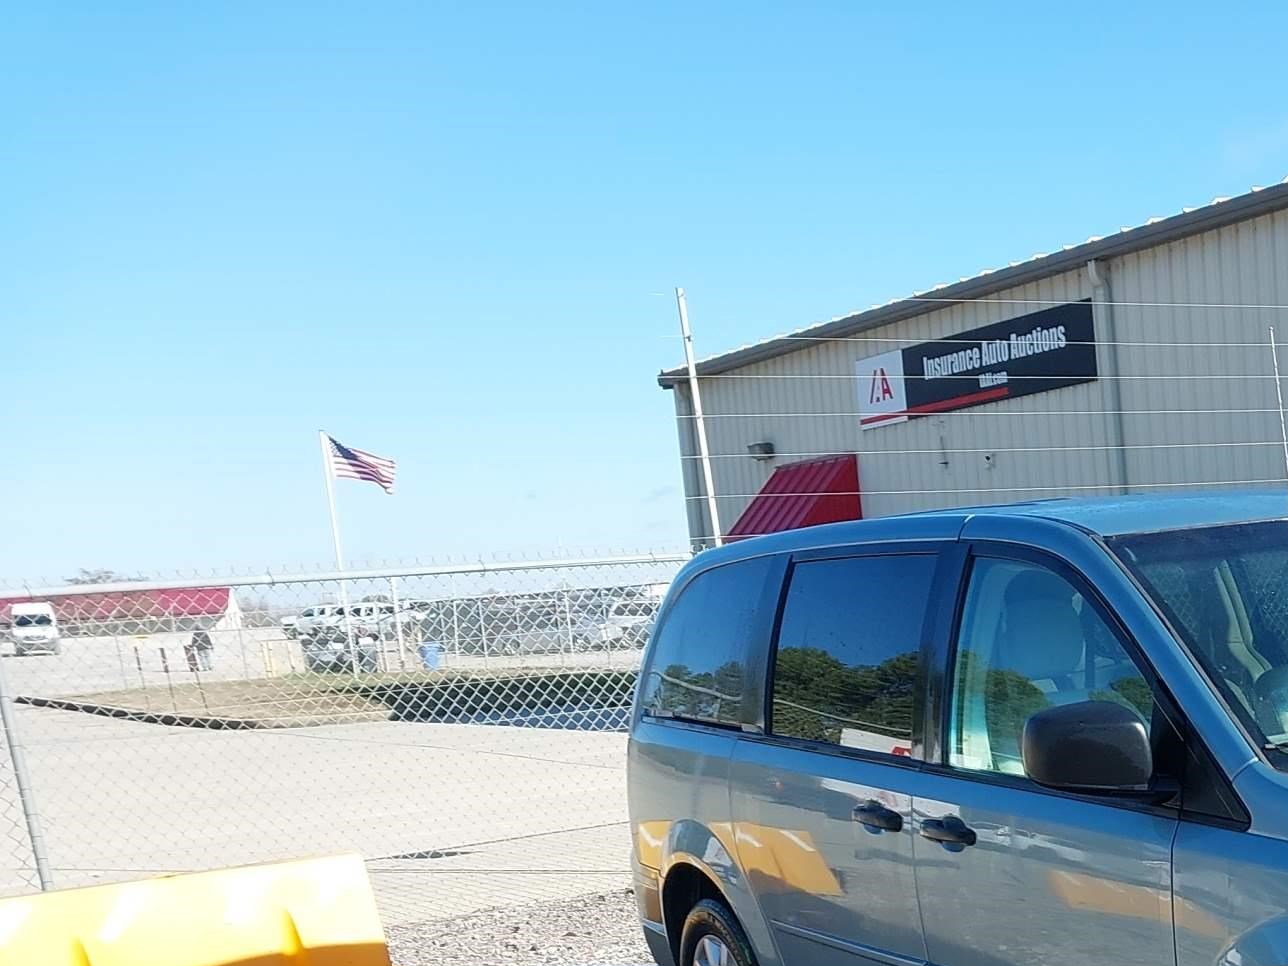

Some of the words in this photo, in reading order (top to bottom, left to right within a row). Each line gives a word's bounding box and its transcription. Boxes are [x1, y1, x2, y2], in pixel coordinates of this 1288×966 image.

[923, 345, 981, 380] Insurance
[982, 336, 1010, 366] Auto
[1010, 325, 1067, 359] Auctions
